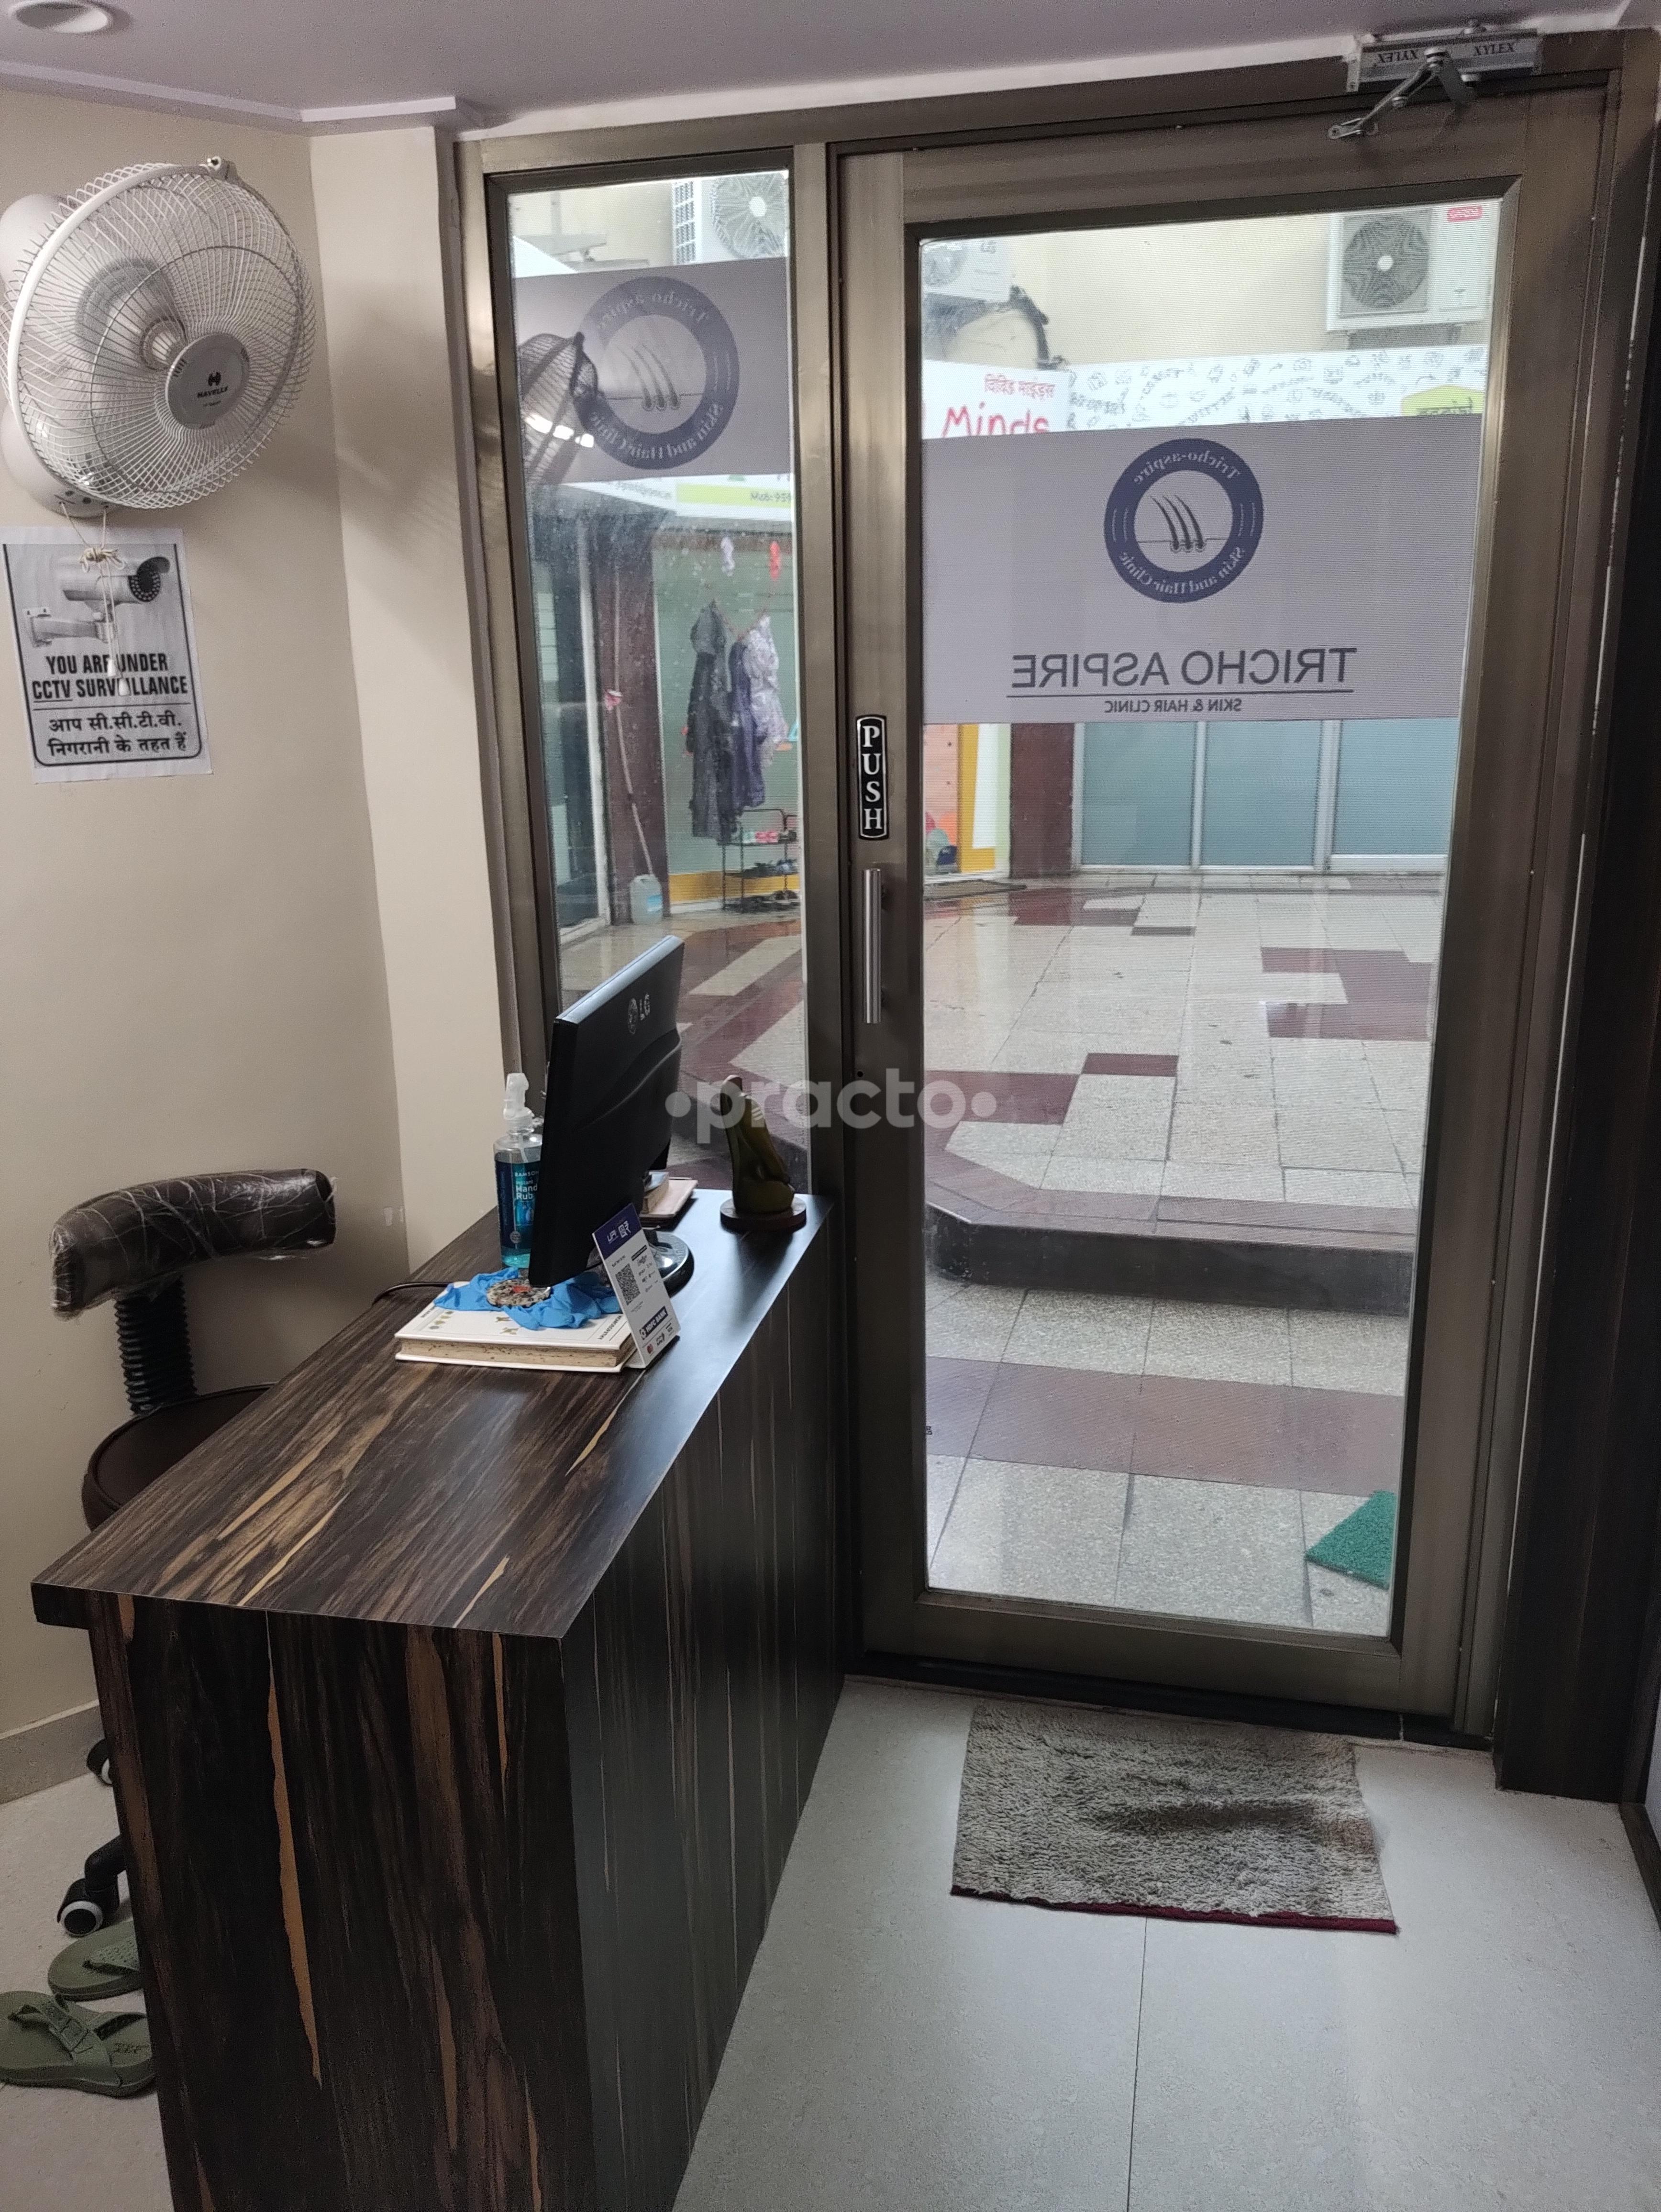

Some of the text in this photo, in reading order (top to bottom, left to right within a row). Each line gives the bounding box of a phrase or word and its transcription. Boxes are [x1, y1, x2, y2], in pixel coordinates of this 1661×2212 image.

[46, 655, 77, 675] YOU
[116, 653, 168, 673] UNDER
[32, 680, 71, 699] CCTV
[48, 718, 82, 733] आप
[47, 731, 187, 756] निगरानी के तहत हैं
[862, 725, 883, 830] PUSH
[640, 994, 651, 1021] LG
[516, 1183, 538, 1193] Hand
[645, 1319, 657, 1332] HDFC
[655, 1310, 667, 1323] BANK
